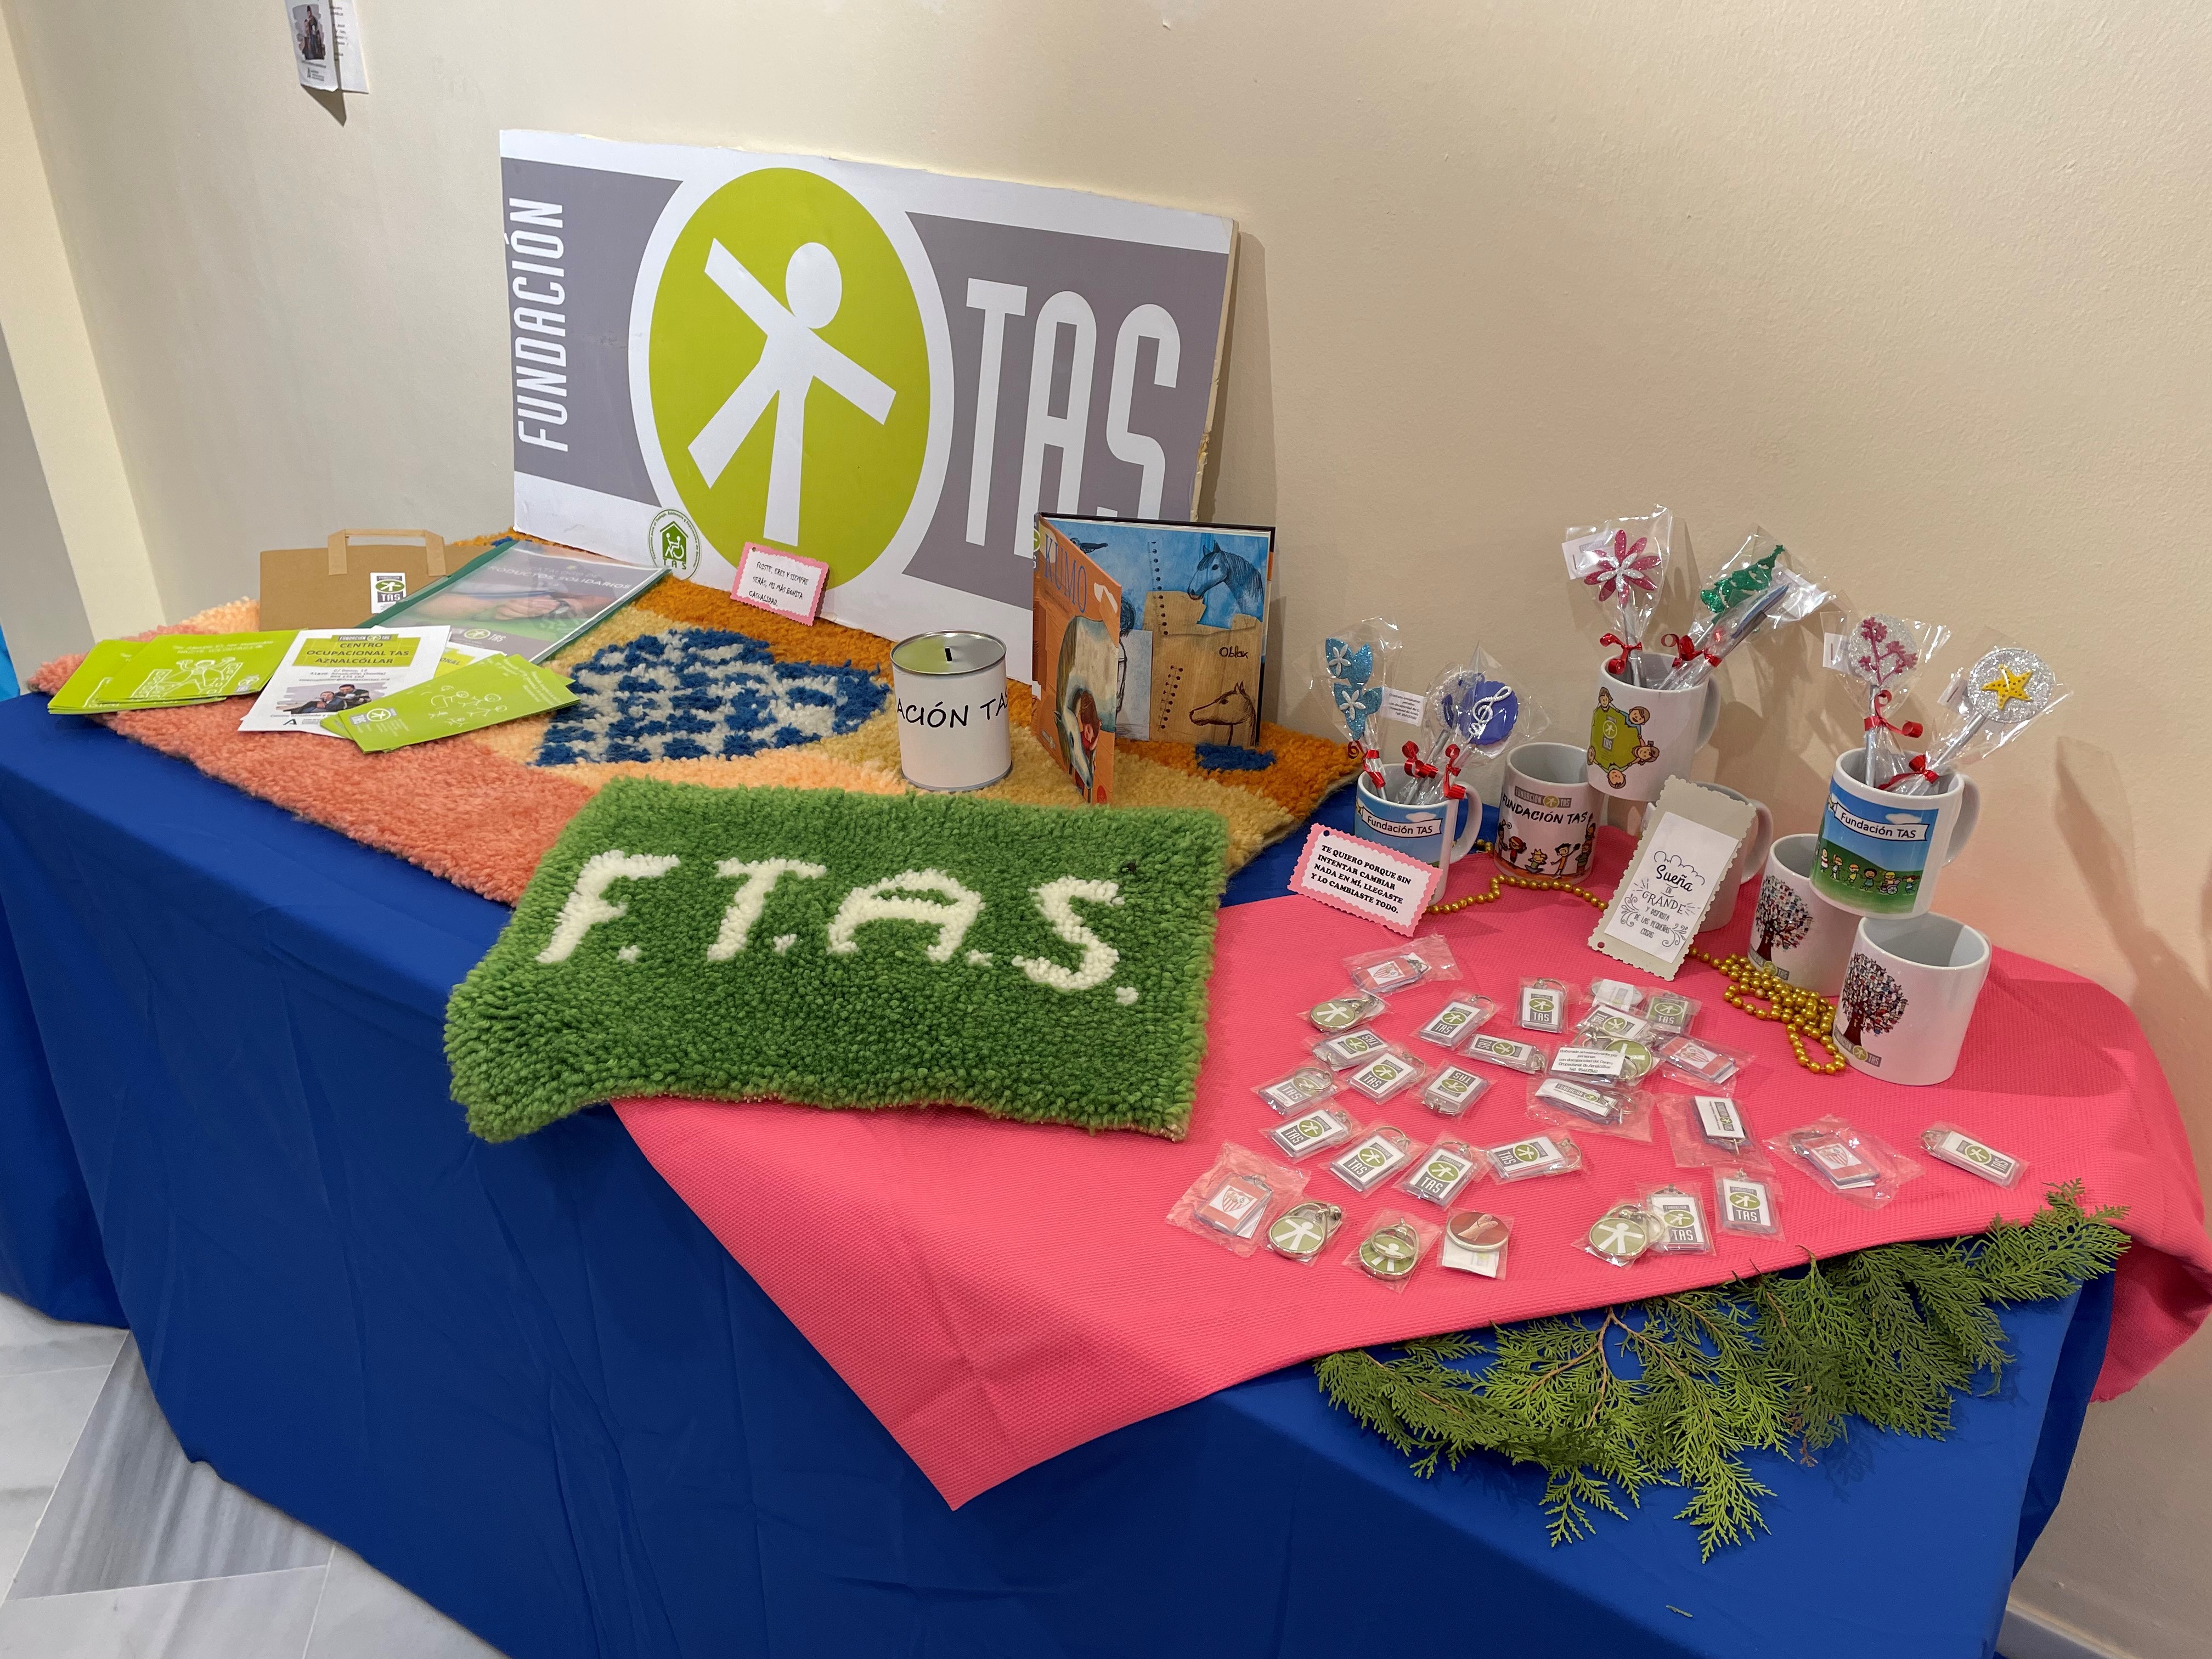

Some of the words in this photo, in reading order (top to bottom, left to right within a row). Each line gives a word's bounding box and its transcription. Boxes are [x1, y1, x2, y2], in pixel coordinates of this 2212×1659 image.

[504, 198, 568, 453] FUNDACIÓN
[966, 277, 1181, 557] TAS
[774, 568, 785, 577] ERES
[790, 574, 809, 585] SIEMPRE
[1045, 534, 1087, 613] KUMO
[749, 590, 778, 606] CASUALIDAD.
[776, 584, 786, 592] MÁS
[786, 588, 803, 600] BONITA
[896, 698, 969, 729] ACIÓN
[979, 684, 1008, 720] TA
[1603, 737, 1612, 750] TAS
[1502, 793, 1564, 824] FUNDACIÓN
[1567, 811, 1588, 825] TAS
[1367, 815, 1413, 834] Fundación
[1417, 825, 1433, 834] TAS
[1841, 812, 1893, 837] Fundación
[1897, 829, 1916, 838] TAS
[1317, 854, 1358, 876] INTENTAR
[1359, 871, 1396, 890] CAMBIAR
[1322, 844, 1331, 854] TE
[1333, 849, 1363, 866] QUIERO
[1364, 861, 1397, 879] PORQUE
[1397, 874, 1412, 885] SIN
[1314, 863, 1337, 878] NADA
[1338, 873, 1350, 883] EN
[1350, 878, 1362, 889] MÍ,
[1363, 883, 1404, 904] LLEGASTE
[1656, 865, 1693, 892] Sueña
[1317, 875, 1328, 884] LO
[1329, 881, 1375, 904] CAMBIASTE
[1375, 899, 1398, 914] TODO.
[1642, 891, 1686, 915] GRANDE
[1650, 909, 1670, 922] DISFRUTA
[535, 850, 1139, 1005] F.T.A.S.
[1640, 928, 1655, 938] COSAS
[1641, 916, 1650, 925] LAS
[1650, 921, 1672, 934] PEQUEÑAS
[1533, 1012, 1549, 1022] TAS
[1658, 1015, 1675, 1024] TAS
[1435, 1023, 1452, 1035] TAS
[1362, 1034, 1379, 1046] TAS
[1477, 1040, 1492, 1049] TAS
[1868, 1054, 1880, 1065] TAS
[1364, 1074, 1382, 1091] TAS
[1453, 1072, 1471, 1085] TAS
[1282, 1086, 1302, 1101] TAS
[1285, 1128, 1304, 1143] TAS
[1498, 1150, 1516, 1165] TAS
[1991, 1158, 2009, 1171] TAS
[1348, 1159, 1368, 1175] TAS
[1420, 1176, 1443, 1193] TAS
[1736, 1209, 1757, 1222] TAS
[1672, 1229, 1694, 1241] TAS
